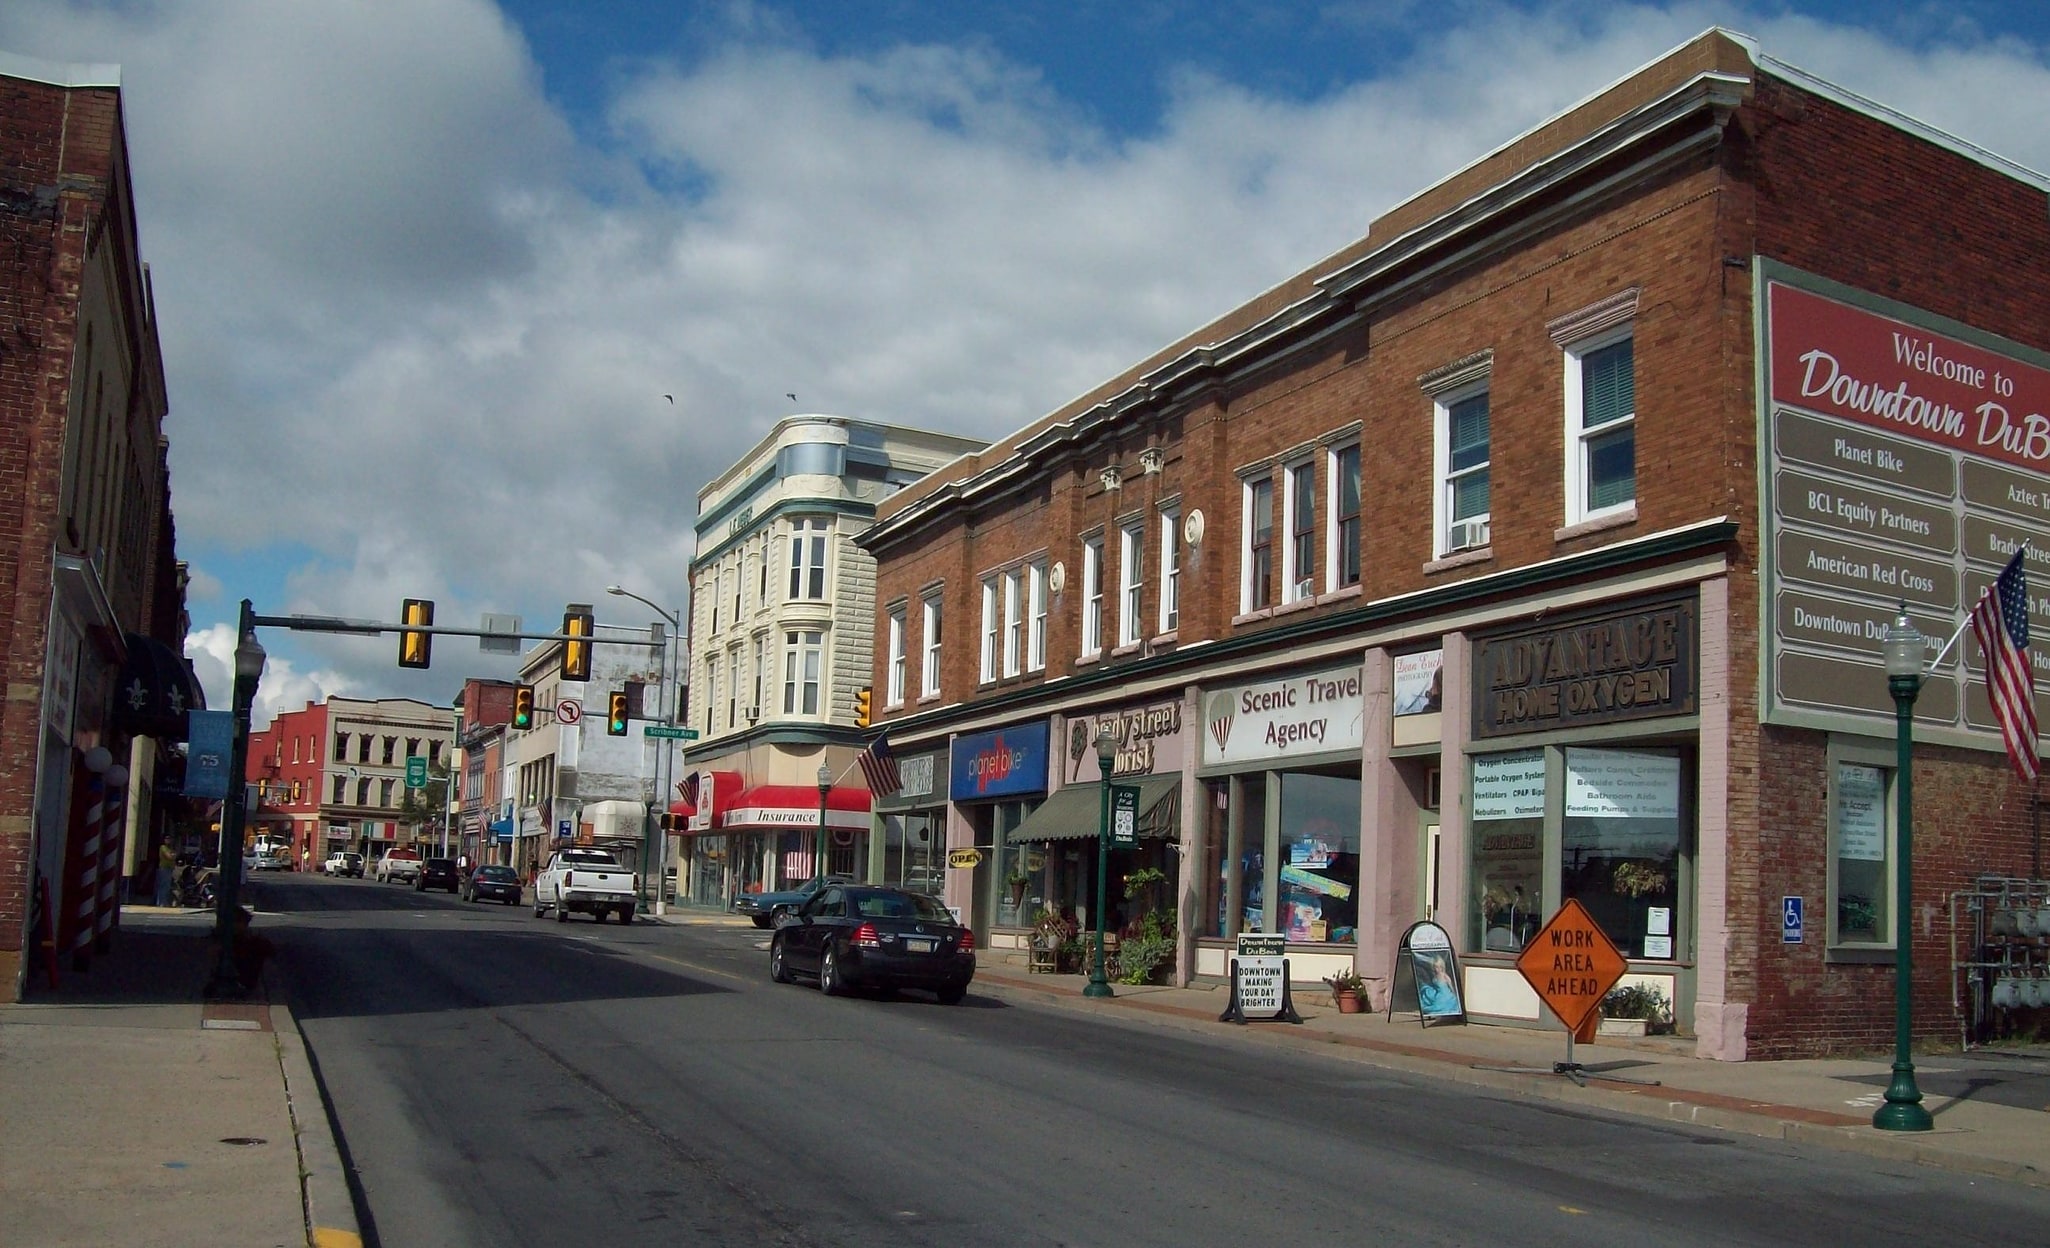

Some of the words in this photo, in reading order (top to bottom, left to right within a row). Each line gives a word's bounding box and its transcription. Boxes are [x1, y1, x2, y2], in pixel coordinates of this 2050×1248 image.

[1892, 331, 1986, 390] Welcome
[1994, 371, 2014, 397] to
[1800, 349, 1966, 438] Downtown
[1834, 438, 1873, 466] Planet
[1877, 449, 1904, 473] Bike
[2007, 484, 2038, 507] Aztec
[1808, 490, 1833, 514] BCL
[1837, 497, 1877, 529] Equity
[1881, 508, 1931, 536] Partners
[1990, 534, 2021, 555] Brady
[1807, 550, 1868, 580] American
[1872, 563, 1896, 585] Red
[1901, 570, 1933, 593] Cross
[1794, 607, 1860, 637] Downtown
[1923, 634, 1944, 657] oup
[1492, 613, 1679, 691] ADVANTAGE
[1241, 683, 1297, 714] Scenic
[1306, 668, 1363, 704] Travel
[1496, 685, 1561, 725] HOME
[1568, 667, 1672, 716] OXYGEN
[1132, 702, 1181, 741] street
[650, 728, 679, 737] Scribner
[1264, 717, 1327, 748] Agency
[968, 750, 999, 782] planet
[1001, 747, 1022, 772] bike
[1113, 740, 1154, 774] lorist
[1478, 759, 1501, 768] Oxygen
[1475, 776, 1500, 784] Portable
[1501, 774, 1522, 783] Oxygen
[1577, 778, 1613, 786] Bedside
[1475, 791, 1507, 800] Ventilators
[1513, 789, 1529, 797] CPAP
[1587, 792, 1633, 800] Bathroom
[757, 809, 816, 823] Insurance
[1567, 804, 1599, 813] Feeding
[1601, 805, 1630, 813] Pumps
[949, 854, 980, 864] OPEN
[1240, 938, 1284, 946] Downtown
[1551, 929, 1594, 948] WORK
[1246, 947, 1277, 955] DuBois
[1239, 967, 1281, 977] DOWNTOWN
[1553, 954, 1594, 972] AREA
[1245, 978, 1273, 986] MAKING
[1547, 978, 1598, 996] AHEAD
[1240, 988, 1259, 997] YOUR
[1261, 988, 1275, 997] DAY
[1240, 998, 1276, 1007] BRIGHTER
